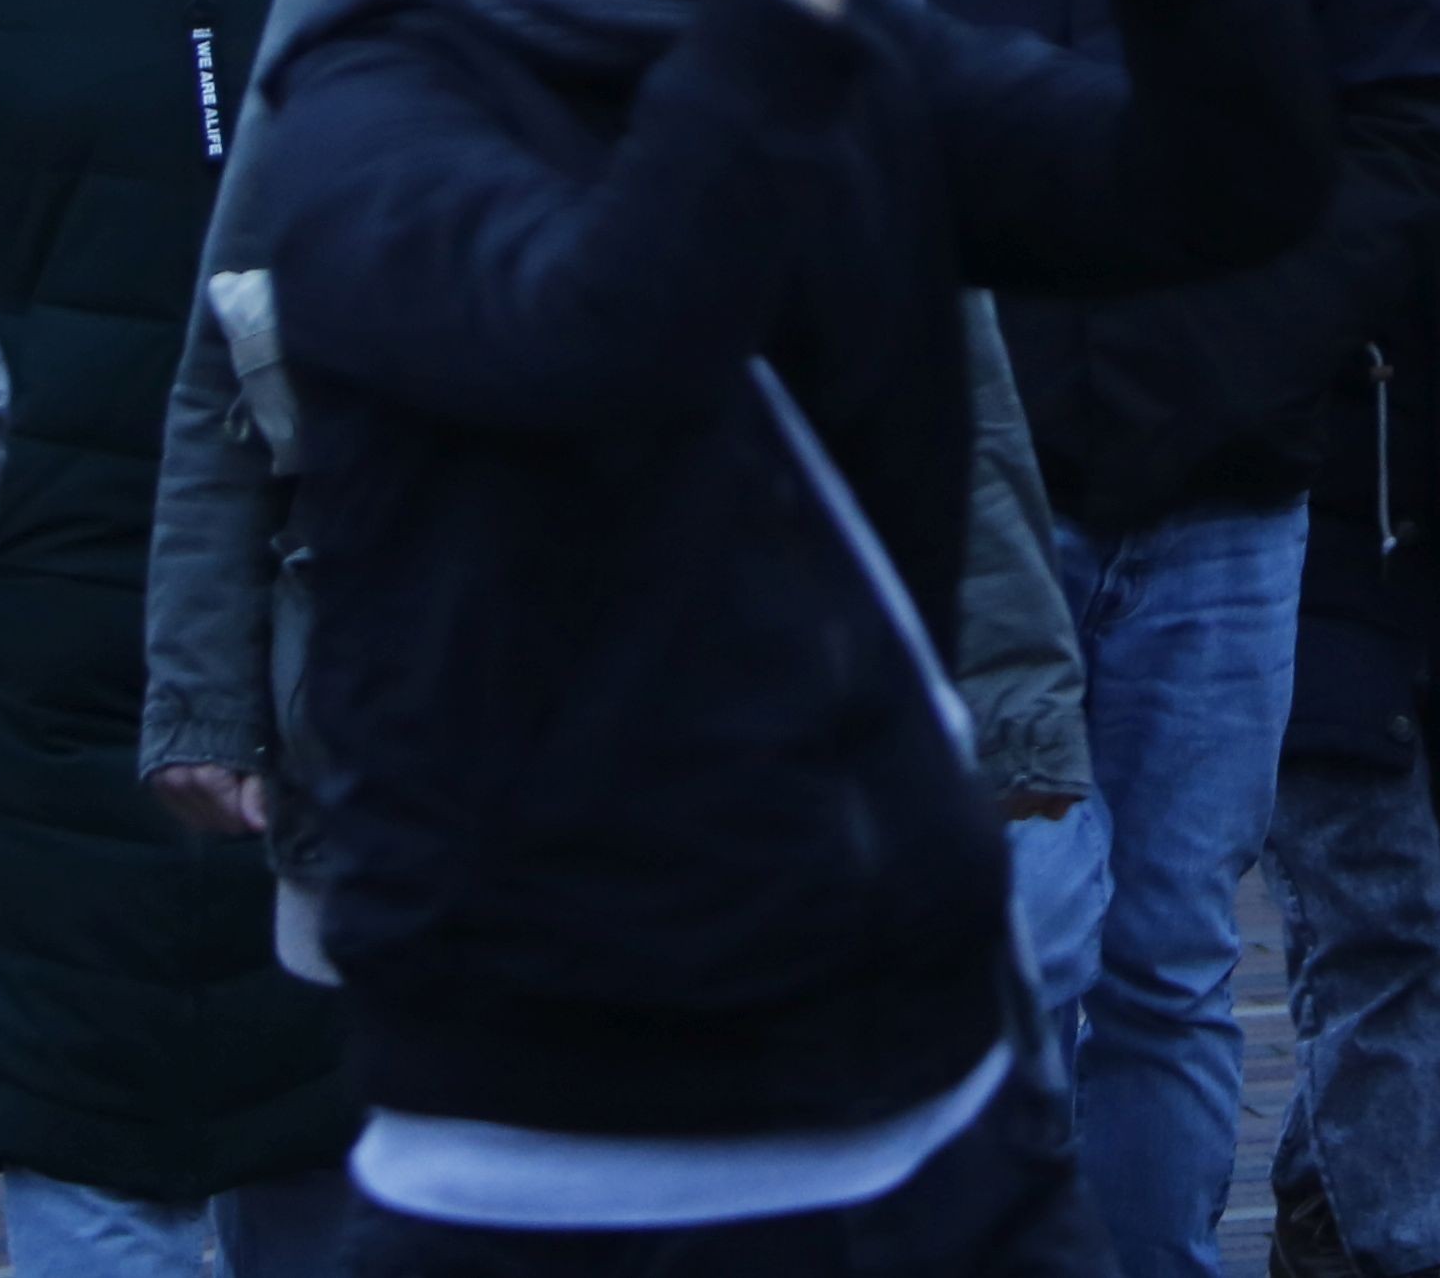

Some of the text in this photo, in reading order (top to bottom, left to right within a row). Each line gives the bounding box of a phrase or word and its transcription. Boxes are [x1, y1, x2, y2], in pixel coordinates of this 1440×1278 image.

[197, 41, 223, 156] WE ARE ALIFE
